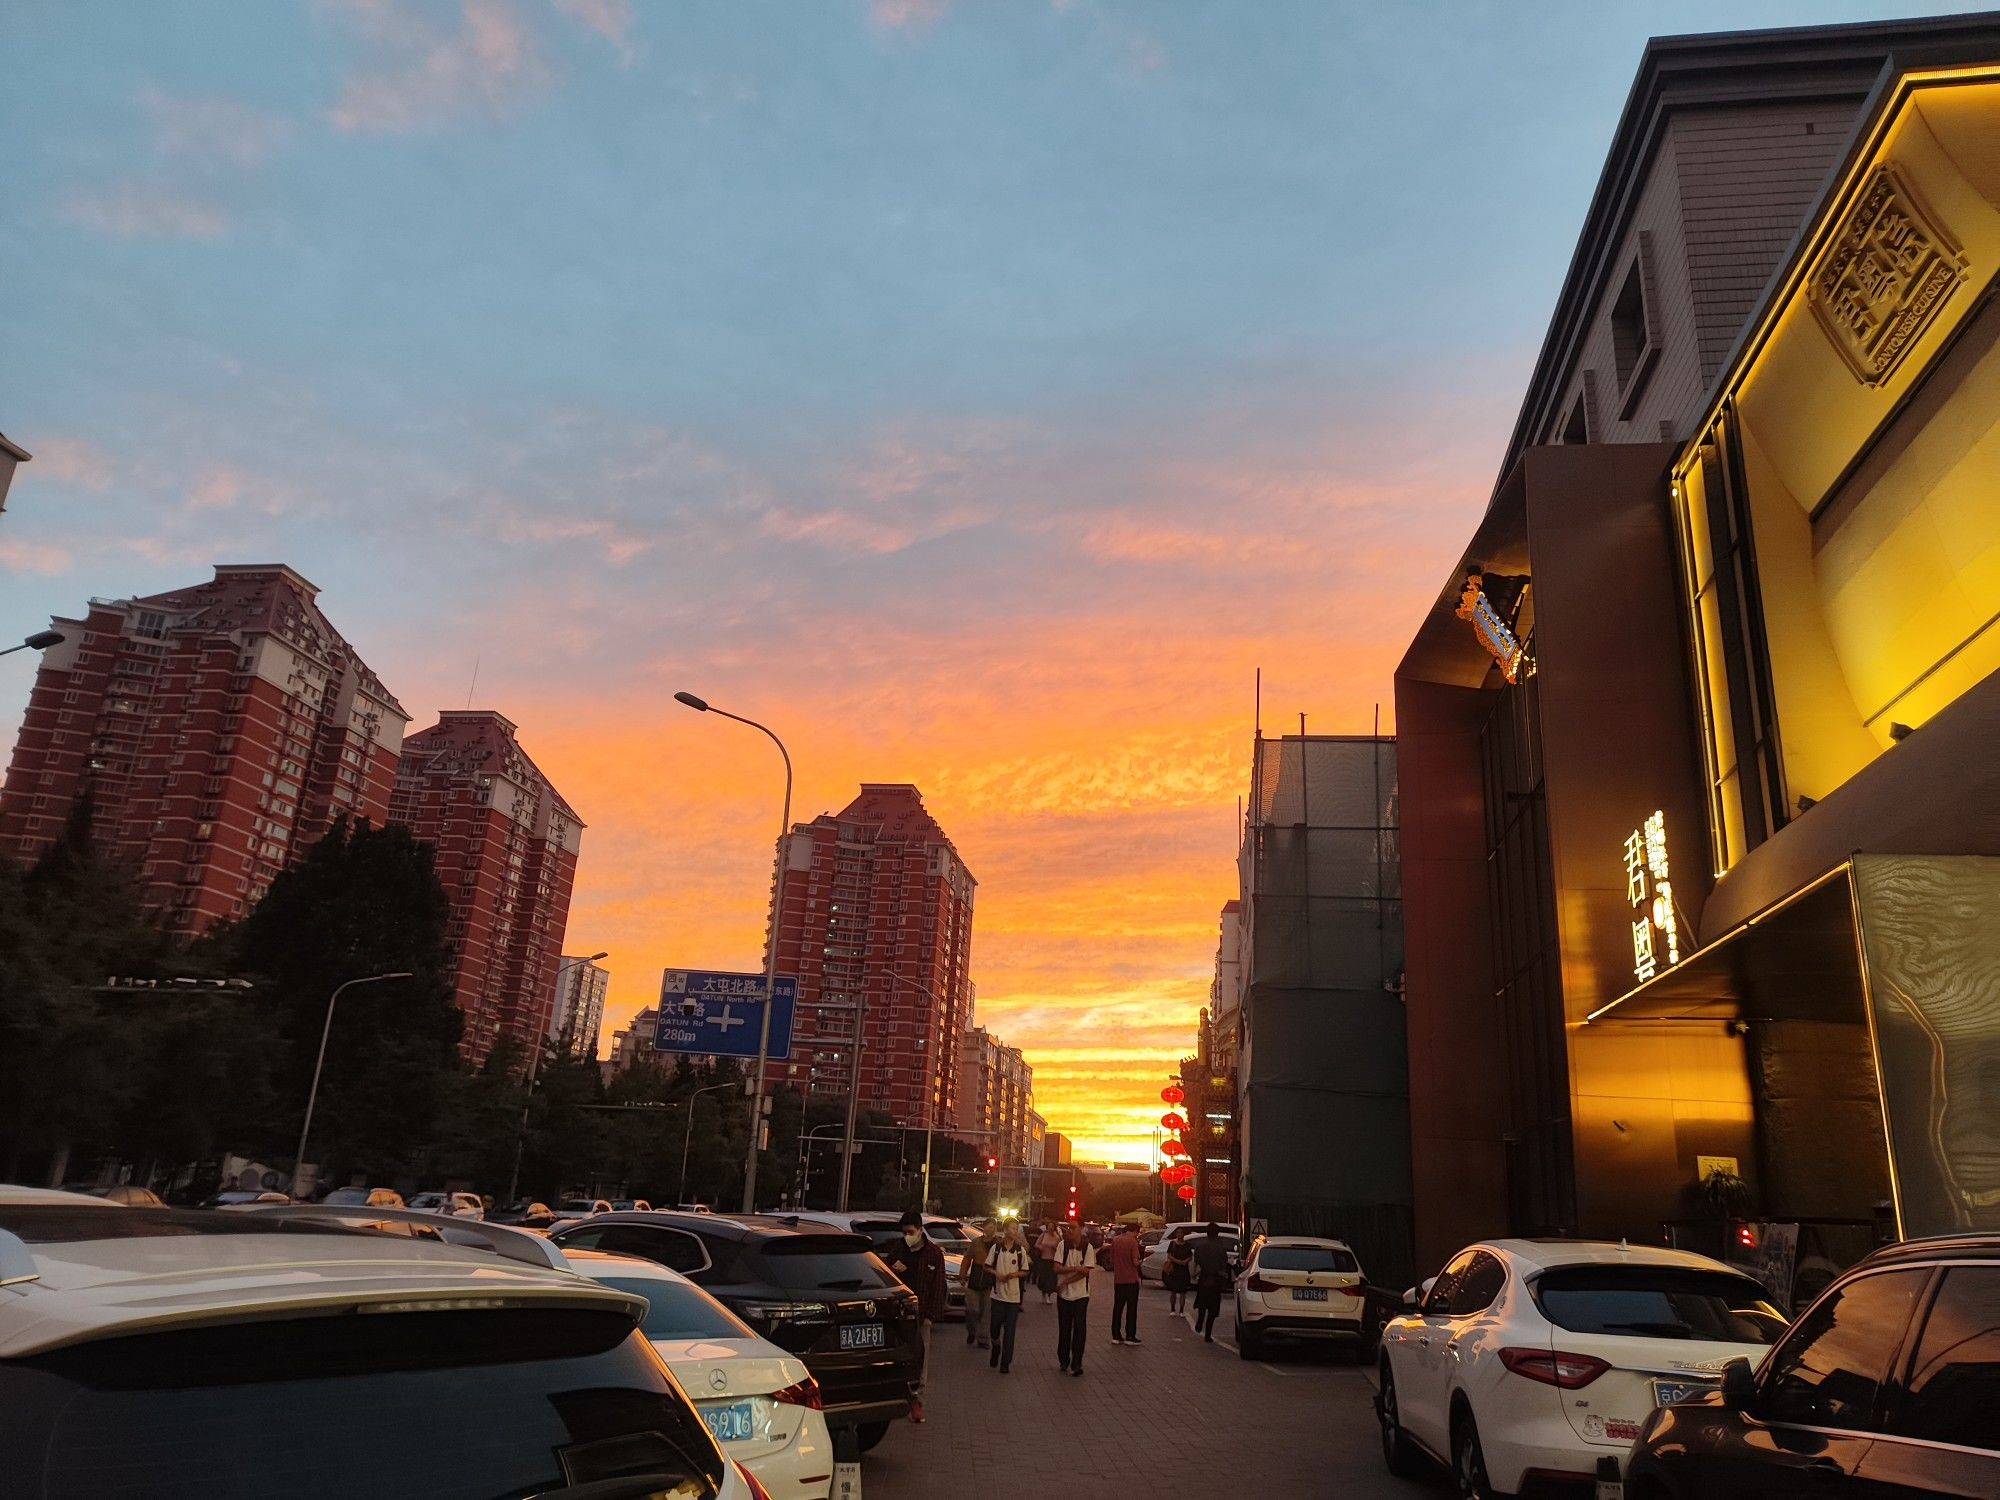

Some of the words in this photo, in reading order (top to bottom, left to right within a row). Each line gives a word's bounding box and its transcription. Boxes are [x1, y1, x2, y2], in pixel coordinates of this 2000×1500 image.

[703, 977, 758, 993] 大屯北路
[660, 1017, 689, 1026] DATUN
[662, 1028, 697, 1042] 280m
